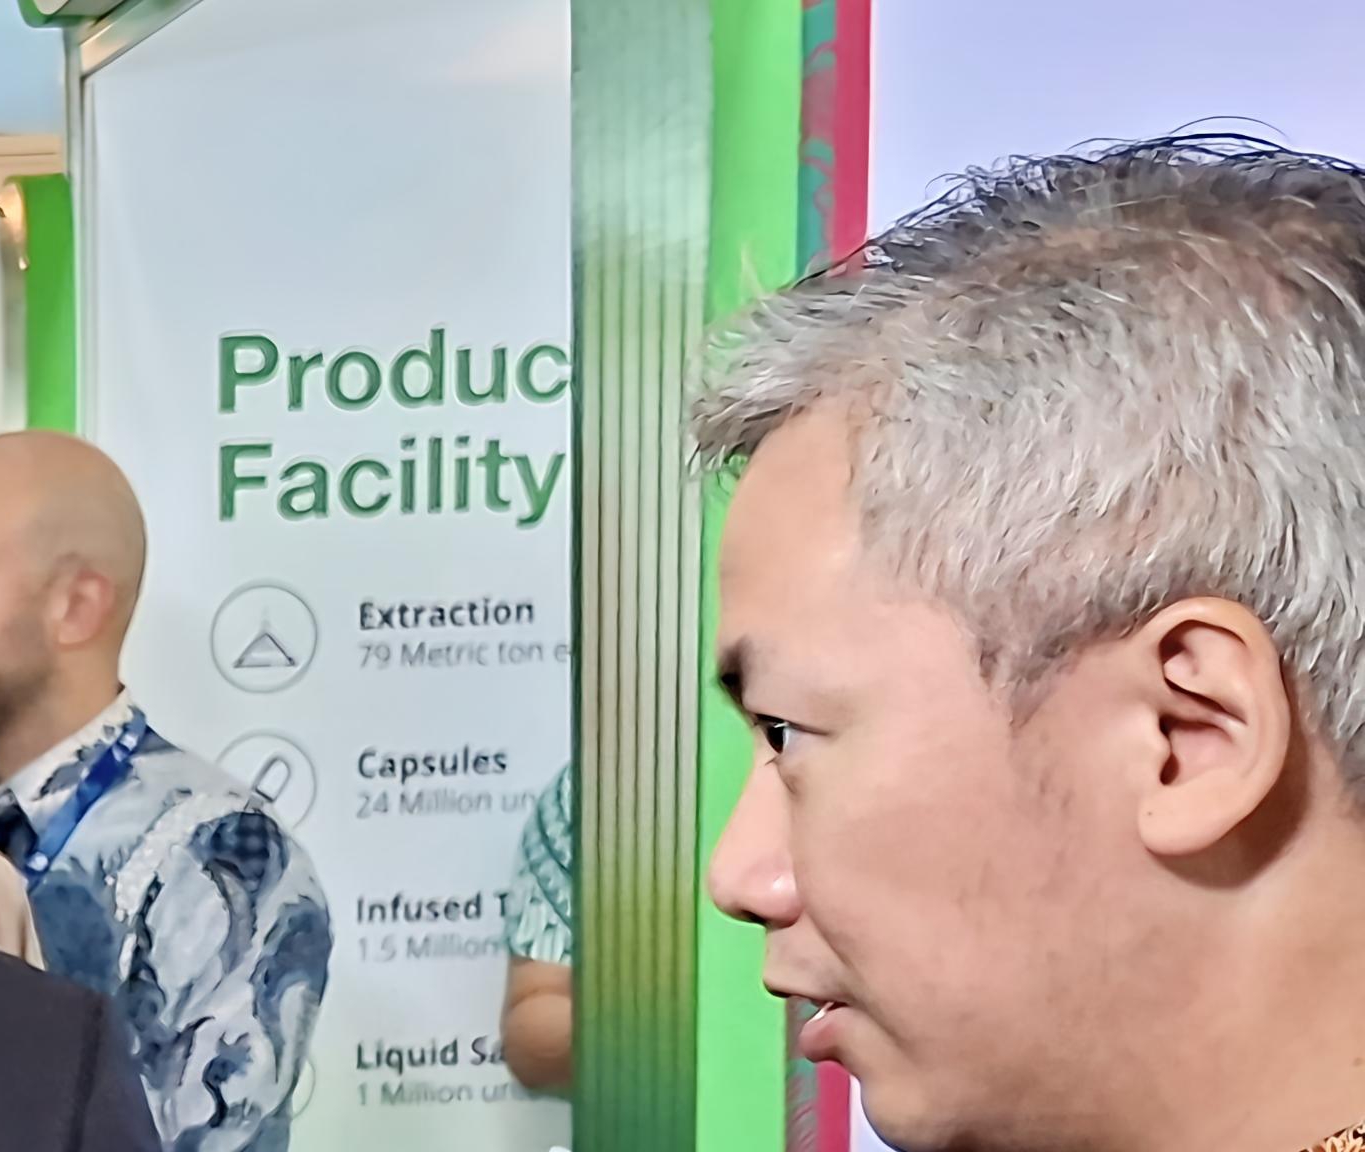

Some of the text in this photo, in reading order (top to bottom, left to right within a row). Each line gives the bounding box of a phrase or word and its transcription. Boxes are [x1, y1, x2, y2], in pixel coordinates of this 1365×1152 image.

[218, 327, 570, 413] Produc
[219, 436, 566, 528] Facility
[359, 598, 535, 631] Extraction
[359, 642, 391, 669] 79
[400, 641, 490, 668] Metric
[498, 641, 544, 665] ton
[358, 744, 508, 785] Capsules
[356, 790, 390, 820] 24
[400, 788, 493, 816] Million
[356, 890, 482, 924] Infused
[406, 931, 504, 959] Million
[356, 1036, 459, 1076] Liquid
[380, 1080, 473, 1106] Million
